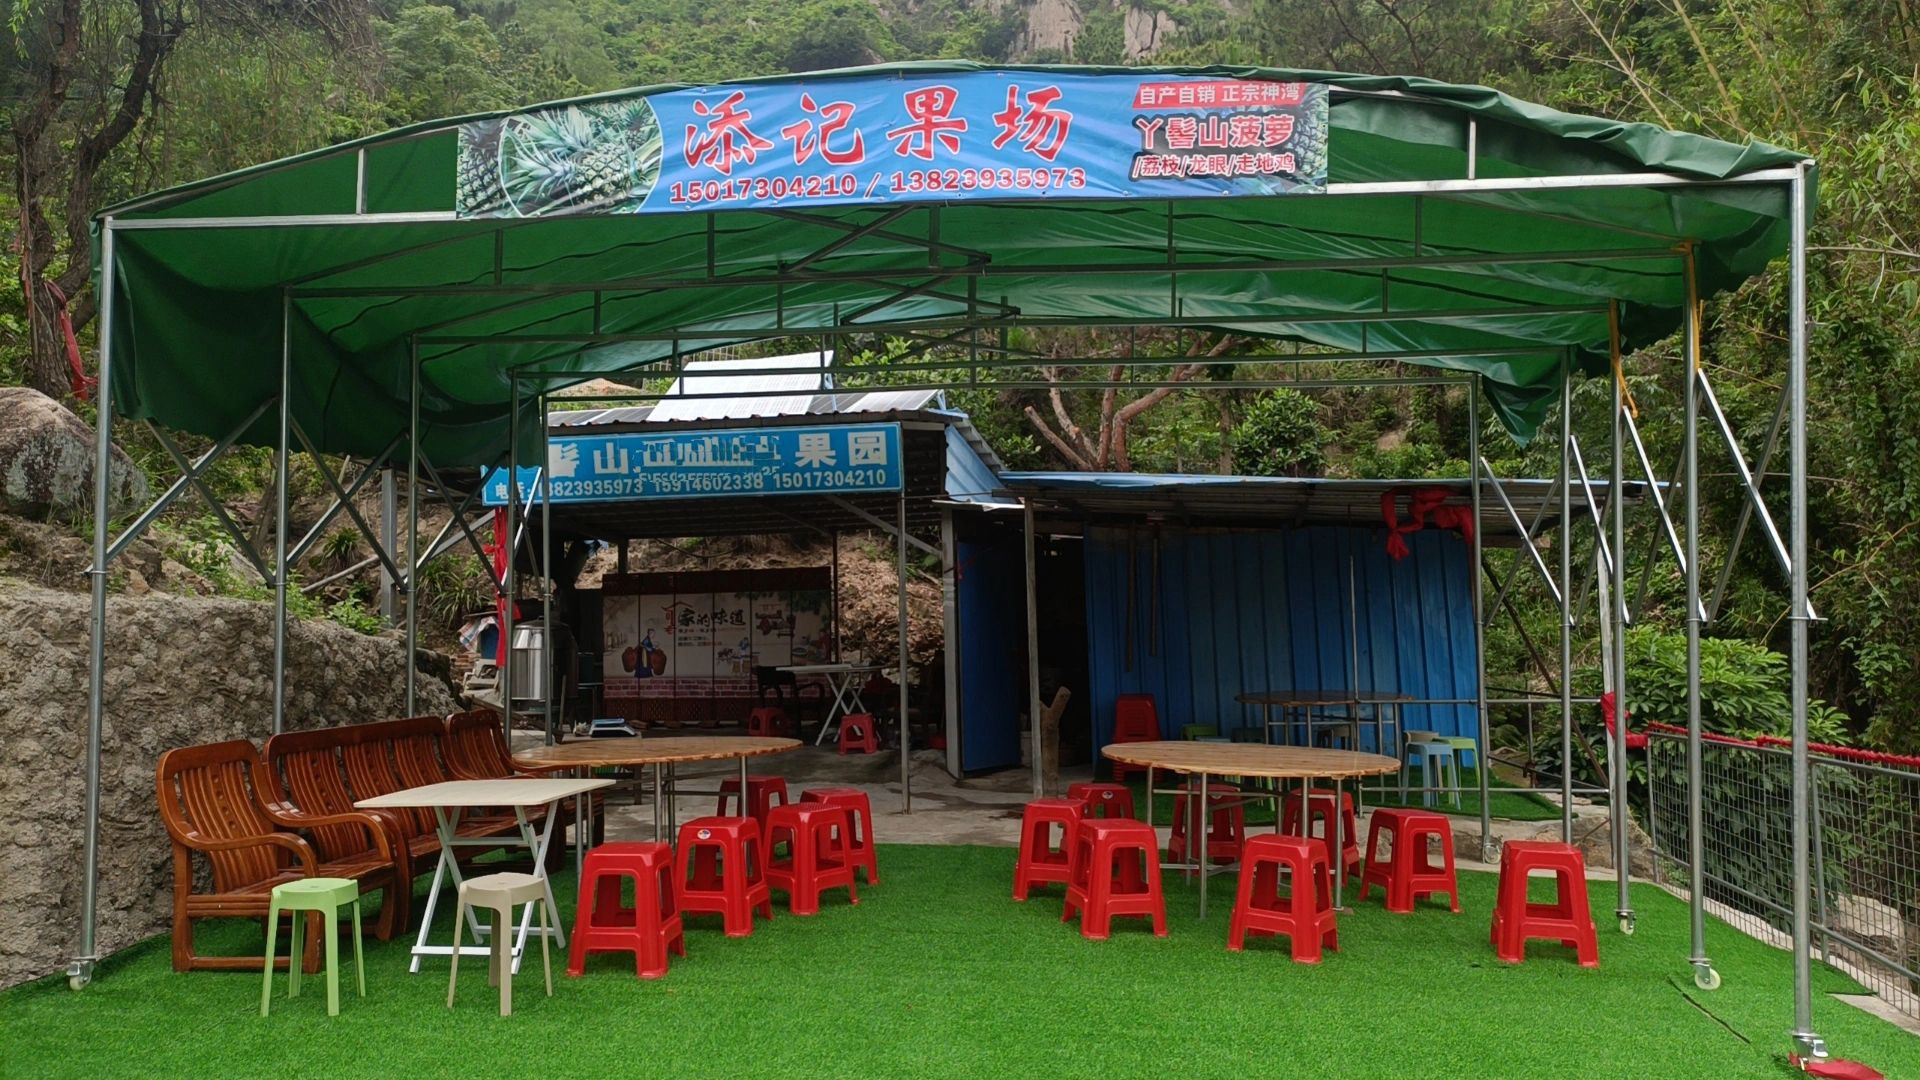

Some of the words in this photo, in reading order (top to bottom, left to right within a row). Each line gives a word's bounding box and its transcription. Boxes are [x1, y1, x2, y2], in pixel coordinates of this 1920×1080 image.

[1139, 85, 1216, 105] 自产自销
[1221, 82, 1301, 103] 正宗神湾
[684, 84, 1074, 175] 添记果场
[1136, 114, 1295, 150] 丫髻山菠萝
[669, 173, 857, 204] 15017304210
[889, 166, 1086, 194] 13823935973
[794, 430, 888, 468] 果园
[655, 474, 764, 493] 15914602338
[774, 468, 887, 489] 15017304210
[678, 607, 746, 627] 家的味道
